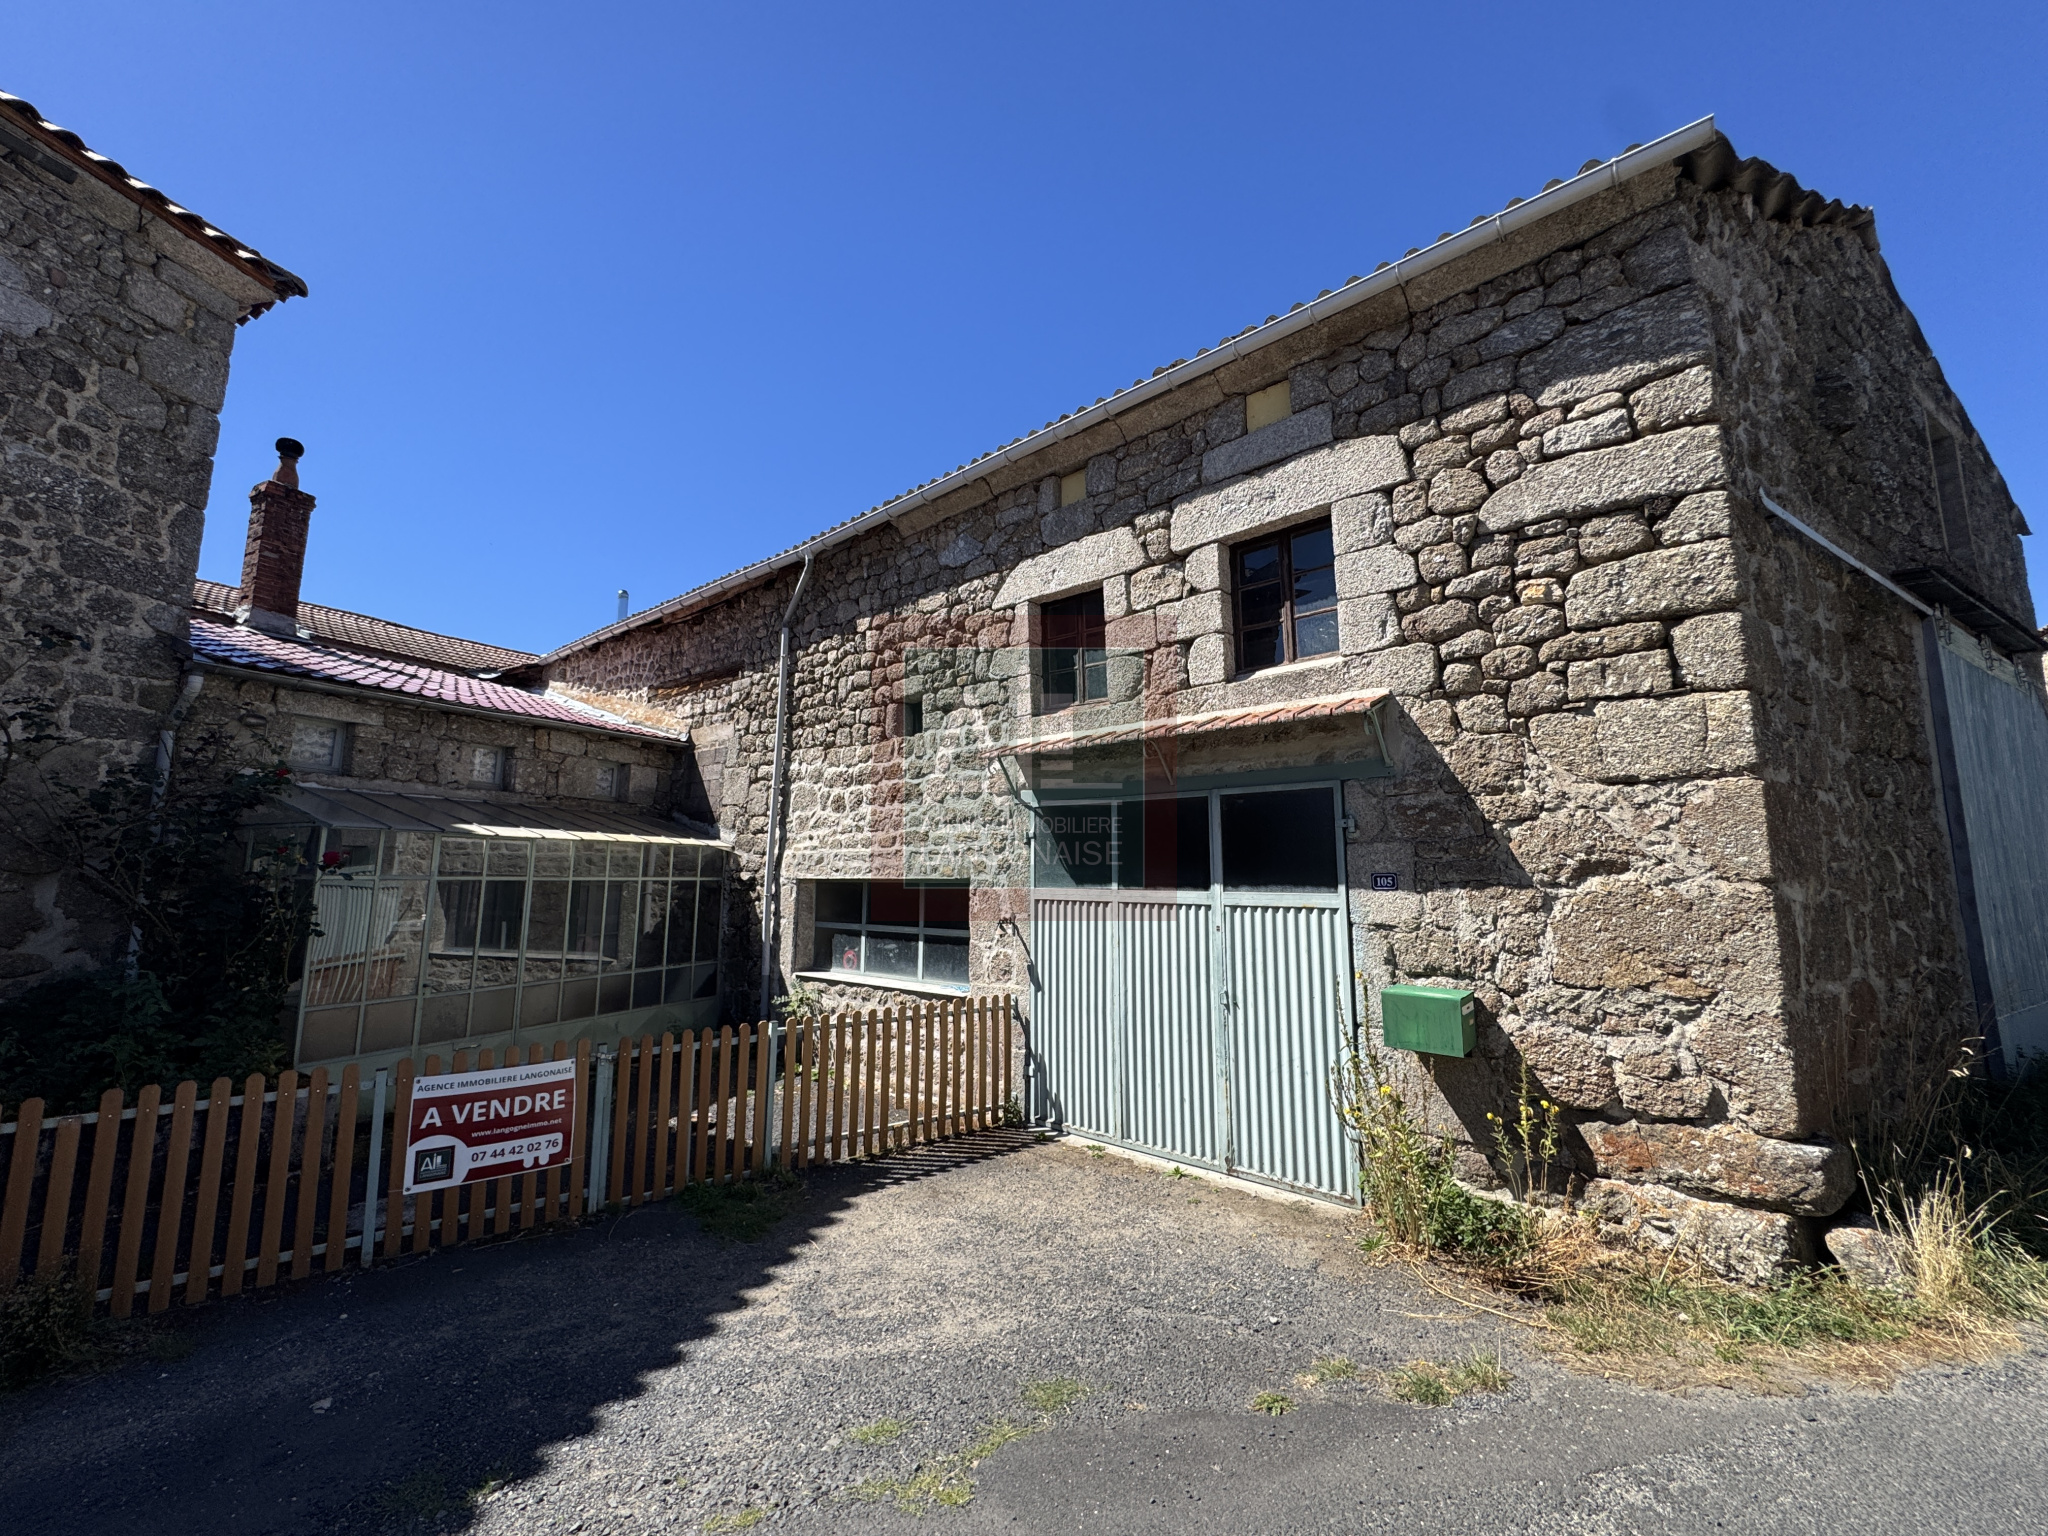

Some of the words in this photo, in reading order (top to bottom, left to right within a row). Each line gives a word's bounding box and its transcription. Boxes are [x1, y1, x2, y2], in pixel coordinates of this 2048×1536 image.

[1376, 877, 1393, 887] 105
[417, 1082, 455, 1092] AGENCE
[457, 1075, 517, 1088] IMMOBILIERE
[520, 1067, 572, 1080] LANGONAISE
[419, 1107, 443, 1130] A
[451, 1089, 566, 1124] VENDRE
[471, 1151, 487, 1162] 07
[489, 1147, 506, 1159] 44
[508, 1144, 524, 1156] 42
[526, 1141, 542, 1153] 02
[544, 1138, 560, 1150] 76
